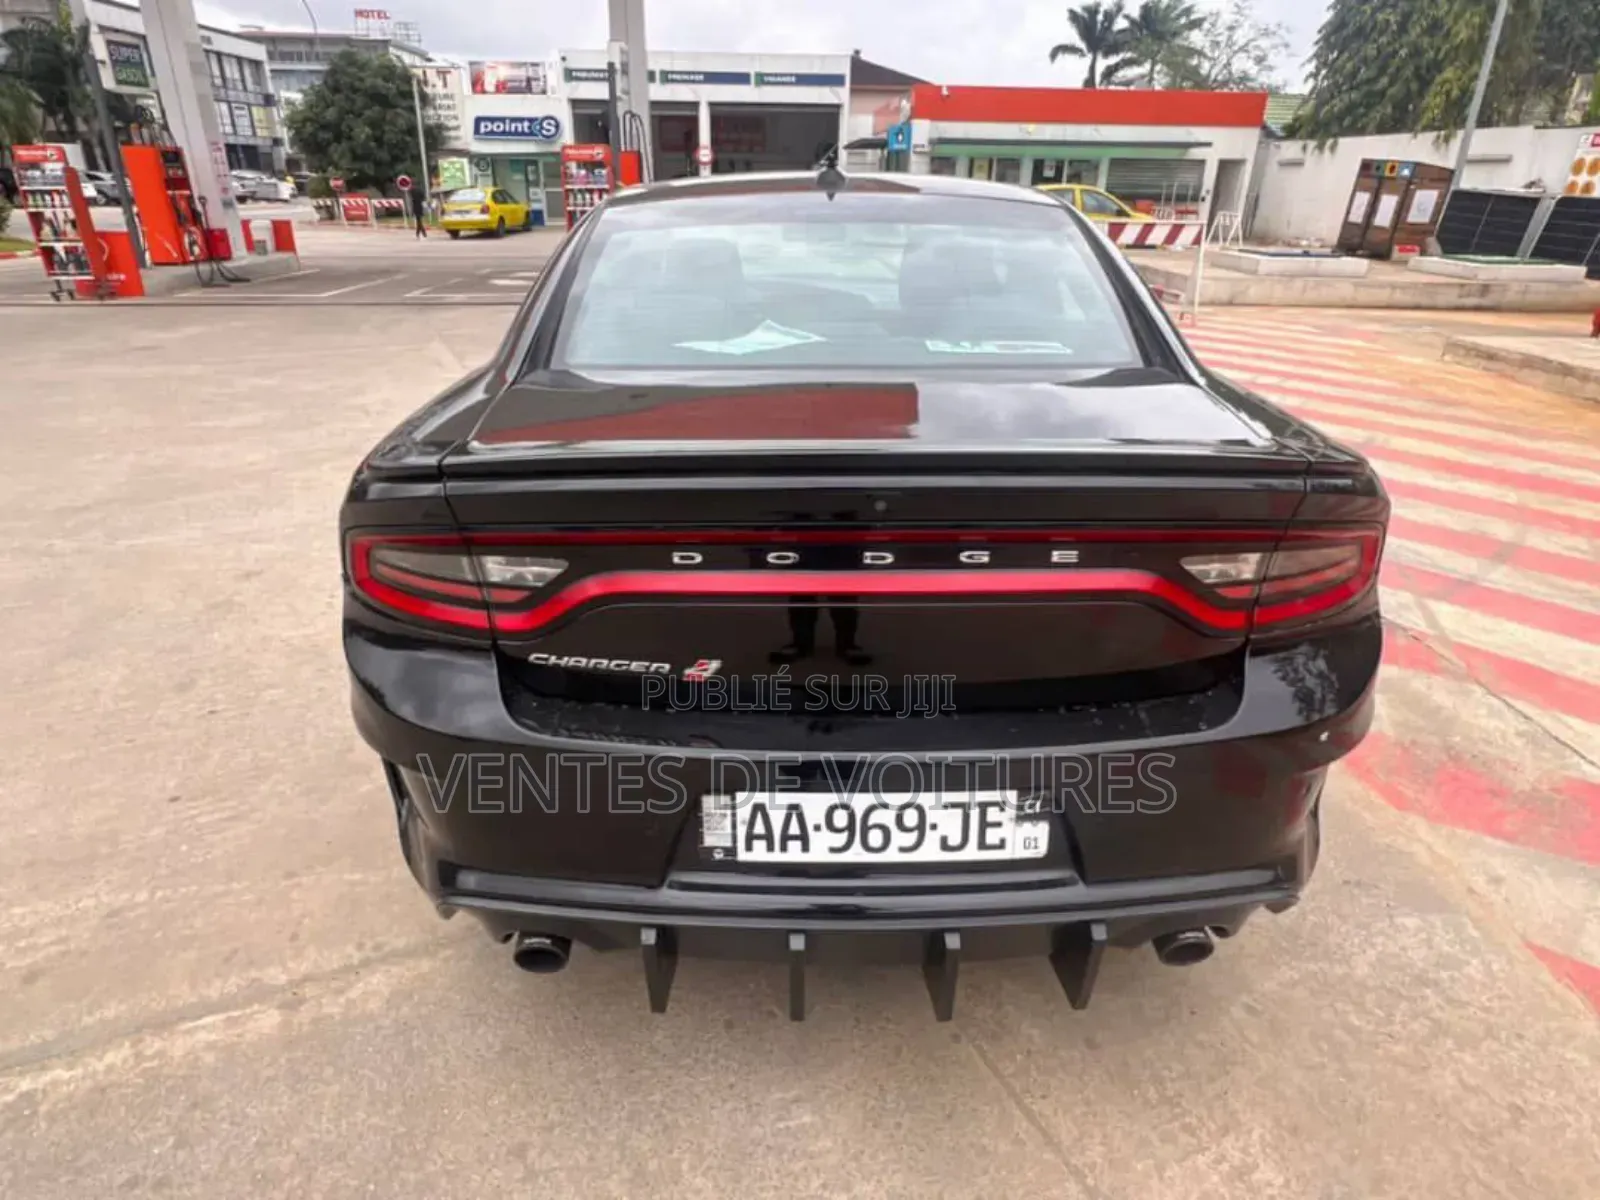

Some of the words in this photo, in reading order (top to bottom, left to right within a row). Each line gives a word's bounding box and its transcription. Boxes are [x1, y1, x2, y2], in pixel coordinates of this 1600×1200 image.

[354, 8, 391, 20] HOTEL
[479, 119, 530, 134] point
[671, 550, 1080, 565] DODGE
[528, 652, 671, 674] CHARGER
[1023, 836, 1041, 851] 01
